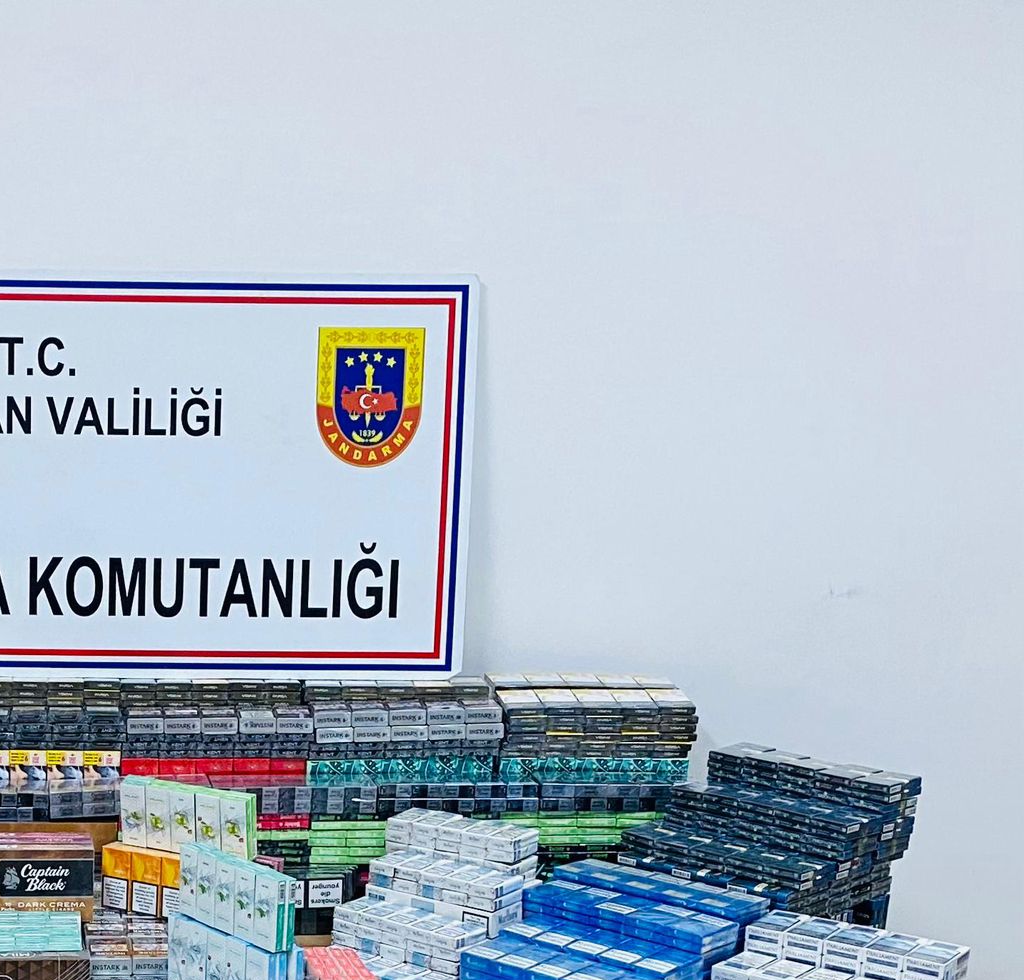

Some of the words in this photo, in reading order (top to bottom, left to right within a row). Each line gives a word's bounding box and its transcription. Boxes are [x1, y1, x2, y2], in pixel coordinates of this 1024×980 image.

[45, 386, 222, 437] VALİLİĞİ
[322, 418, 414, 462] JANDARMA
[359, 429, 376, 437] 1839
[28, 542, 400, 620] KOMUTANLIĞI
[20, 863, 70, 879] Captain
[25, 878, 66, 892] Black
[92, 963, 121, 971] INSTARK
